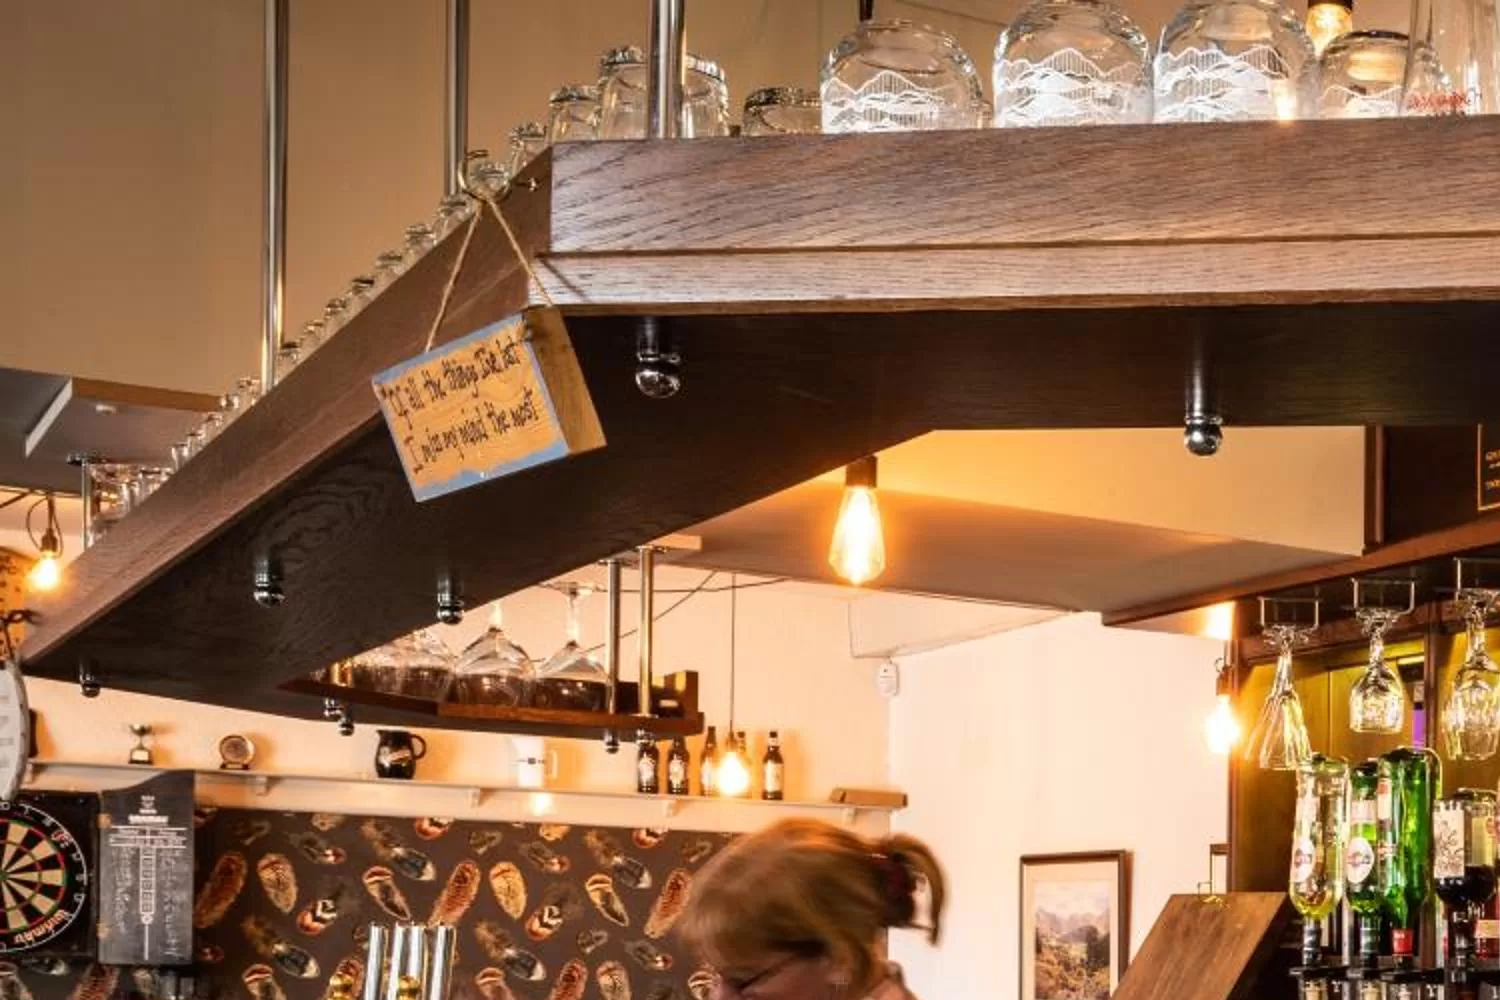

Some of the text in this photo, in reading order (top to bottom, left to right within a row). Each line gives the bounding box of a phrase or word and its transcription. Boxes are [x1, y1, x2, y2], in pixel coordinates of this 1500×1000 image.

[421, 370, 447, 402] the
[441, 358, 480, 398] things
[442, 425, 465, 460] my
[485, 402, 511, 433] the
[511, 387, 539, 427] most
